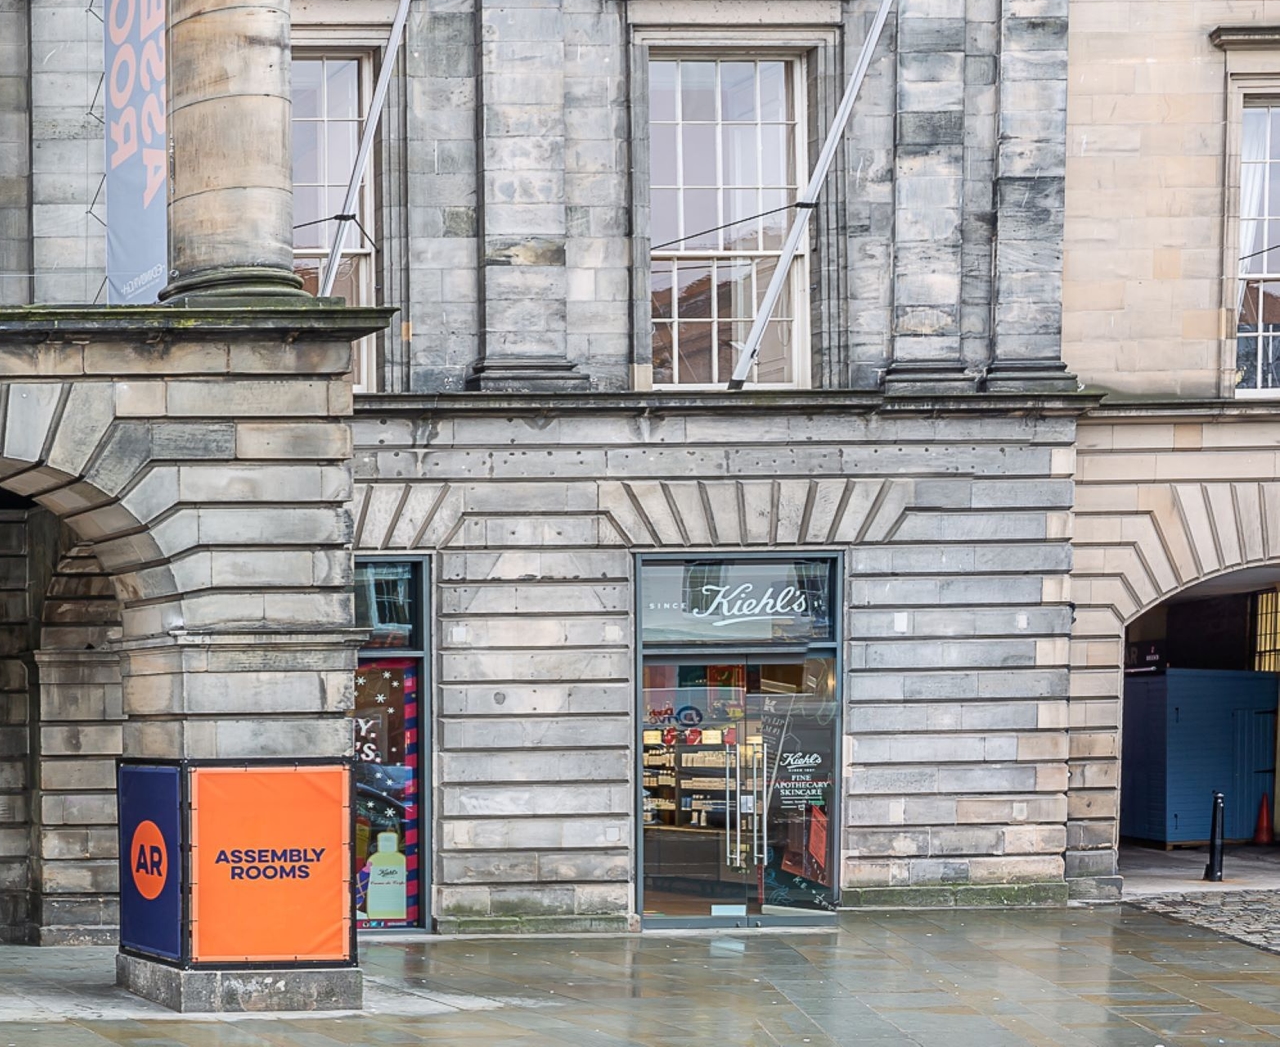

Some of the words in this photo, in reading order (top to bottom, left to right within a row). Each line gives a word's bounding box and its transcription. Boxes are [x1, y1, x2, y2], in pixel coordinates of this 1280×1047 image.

[692, 583, 807, 618] Kiehl's
[780, 752, 822, 766] Kiehl's
[773, 781, 829, 789] APOTHECARY
[135, 844, 163, 877] AR
[215, 848, 326, 864] ASSEMBLY
[230, 865, 310, 880] ROOMS
